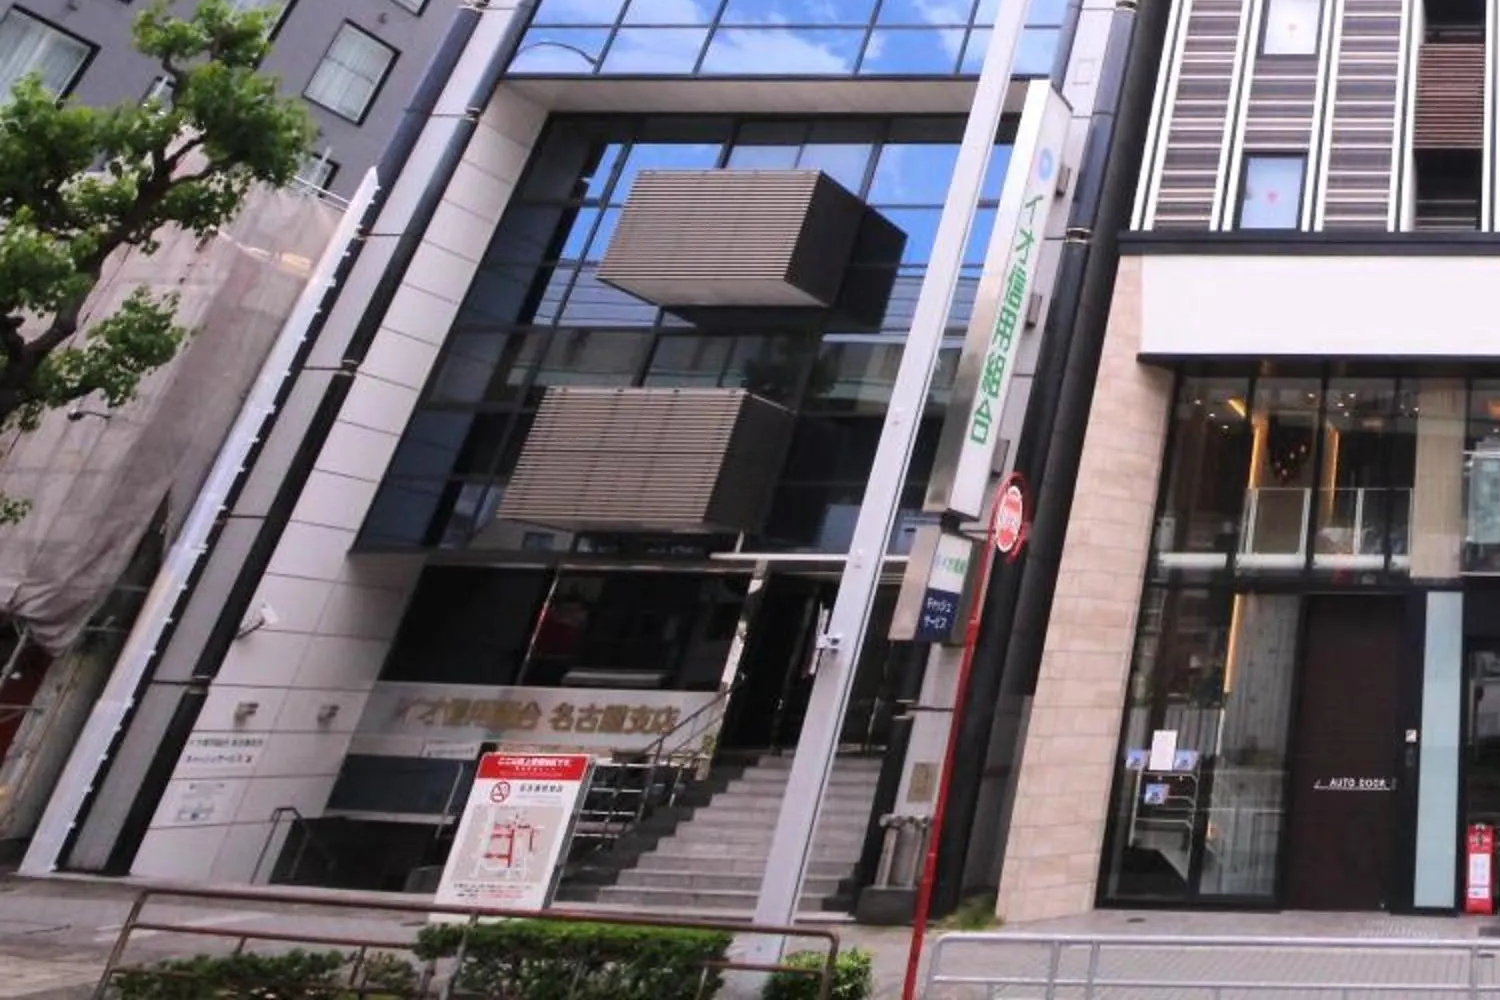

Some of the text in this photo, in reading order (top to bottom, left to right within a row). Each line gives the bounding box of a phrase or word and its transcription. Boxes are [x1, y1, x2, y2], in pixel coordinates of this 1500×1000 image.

[970, 194, 1044, 445] イオ信用組合
